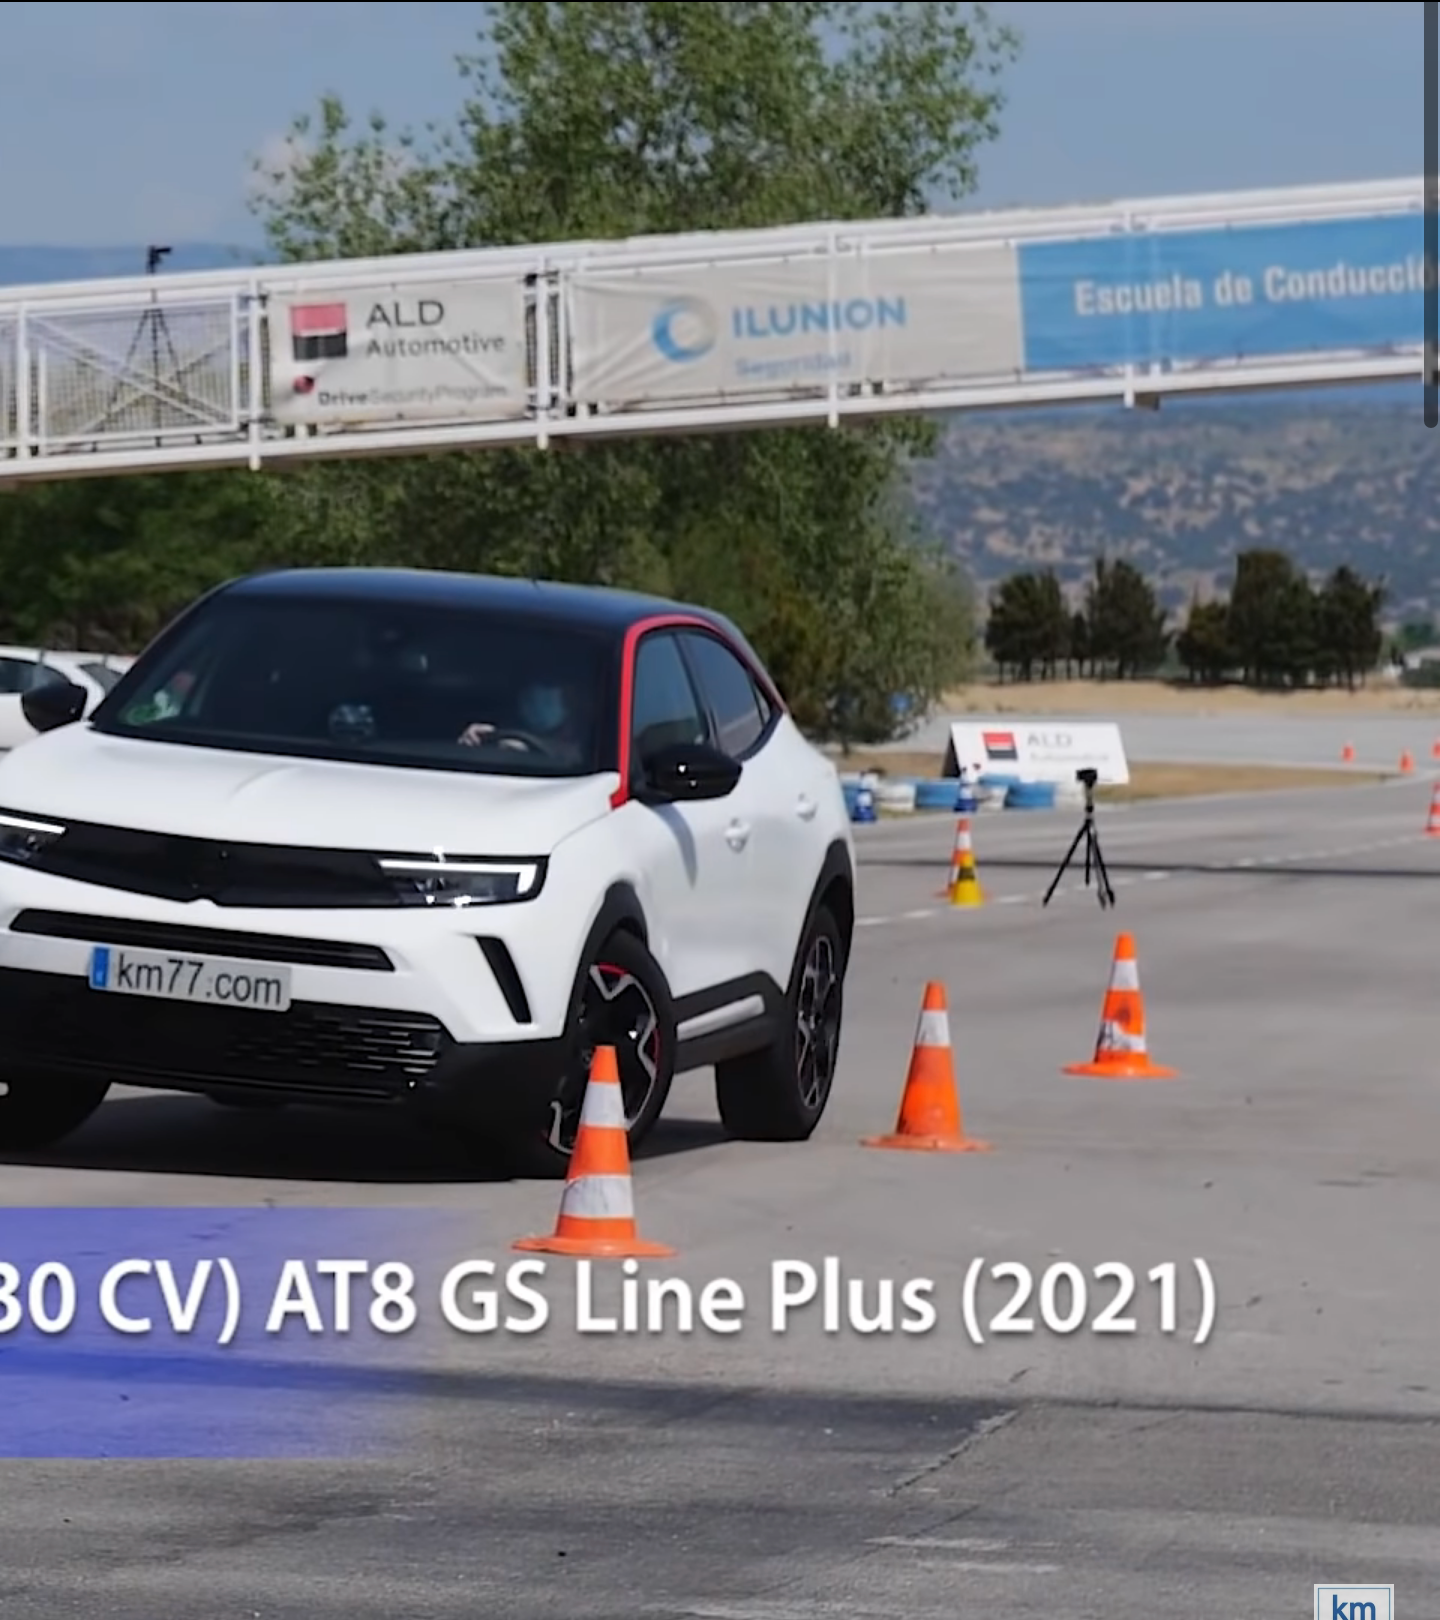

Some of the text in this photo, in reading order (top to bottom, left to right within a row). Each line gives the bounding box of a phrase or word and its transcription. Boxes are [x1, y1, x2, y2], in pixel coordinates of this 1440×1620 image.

[1073, 274, 1202, 317] Escuela
[1213, 268, 1253, 307] de
[365, 300, 445, 330] ALD
[731, 296, 908, 339] ILUNION
[366, 332, 506, 359] Automotive
[1027, 733, 1073, 747] ALD
[117, 951, 282, 1006] km77.com
